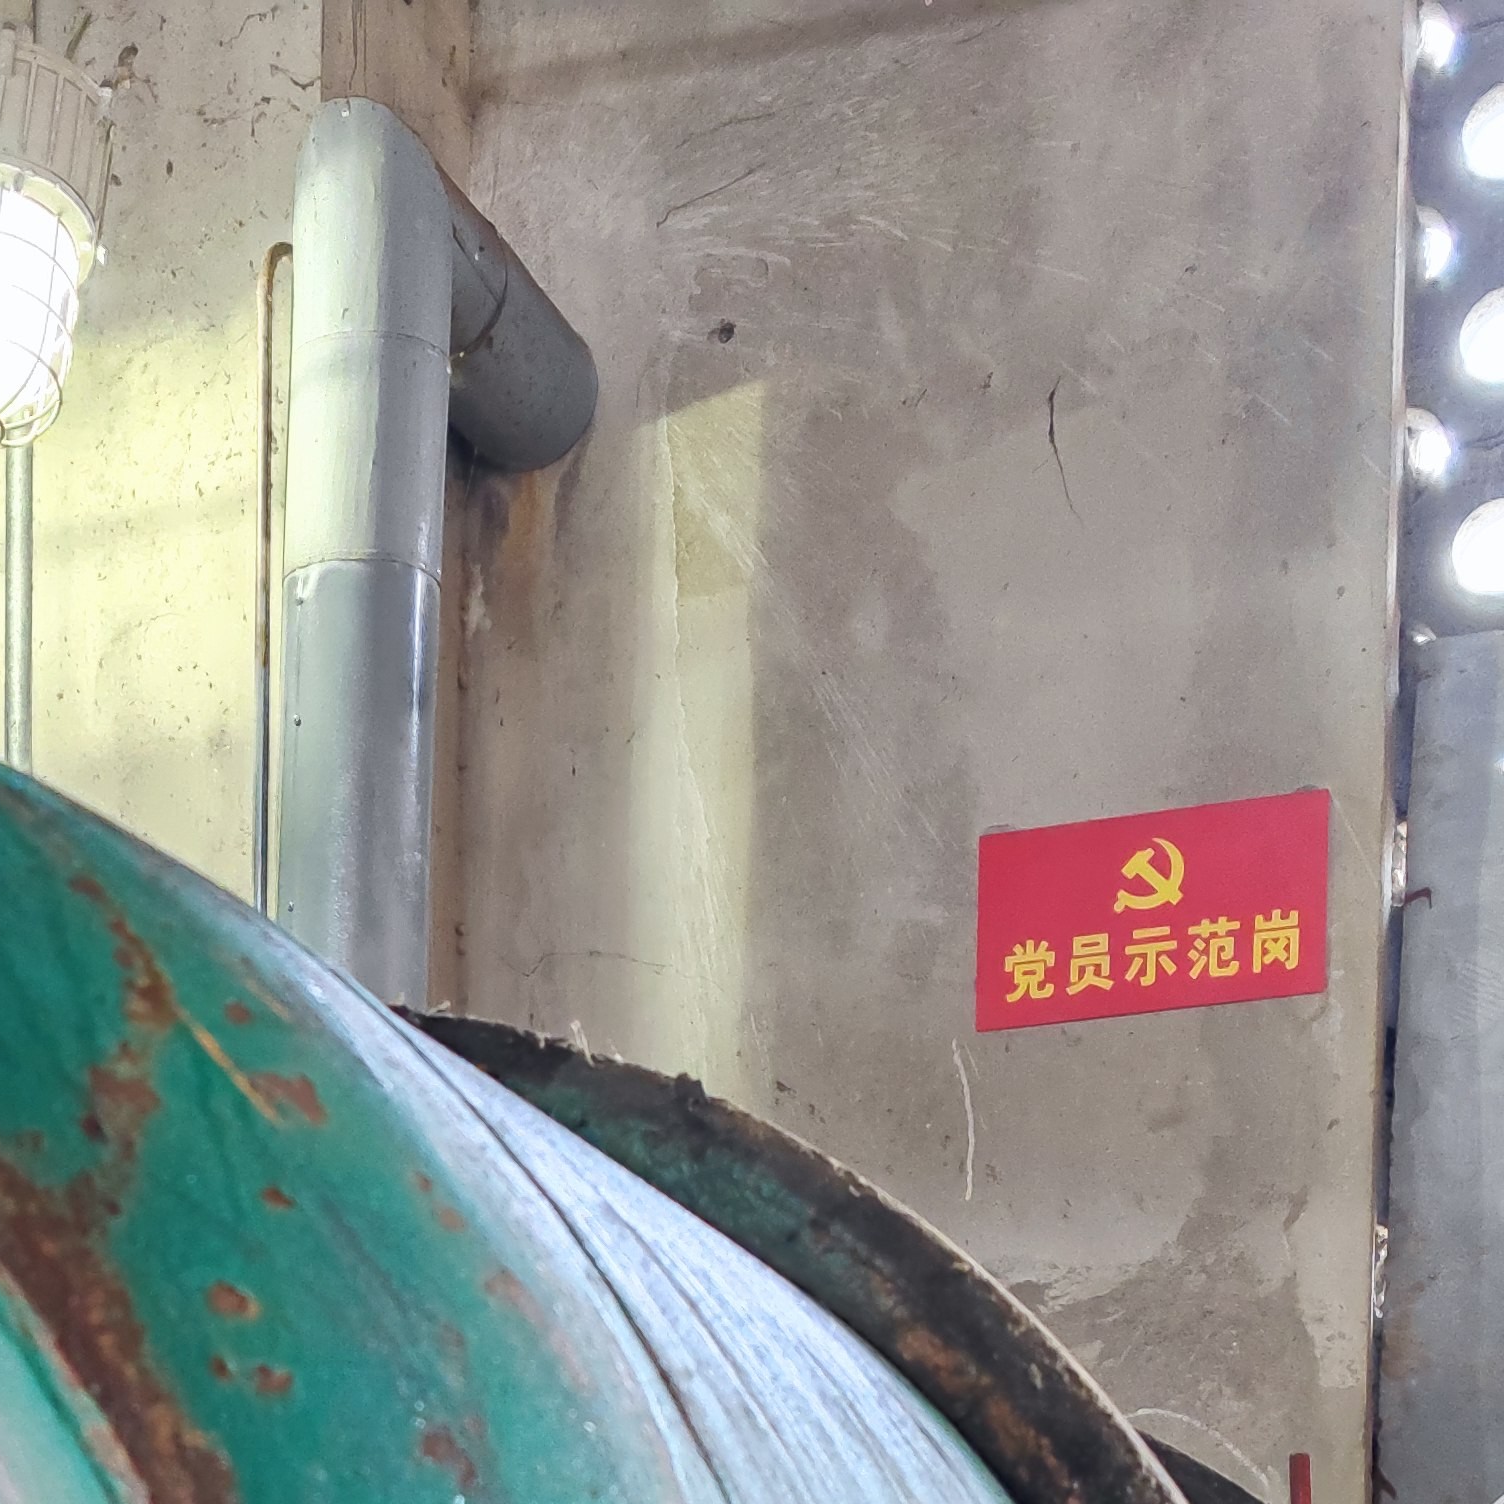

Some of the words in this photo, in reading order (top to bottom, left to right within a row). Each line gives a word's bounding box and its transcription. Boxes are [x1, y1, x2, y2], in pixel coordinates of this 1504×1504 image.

[1004, 908, 1300, 1004] 党员示范岗
